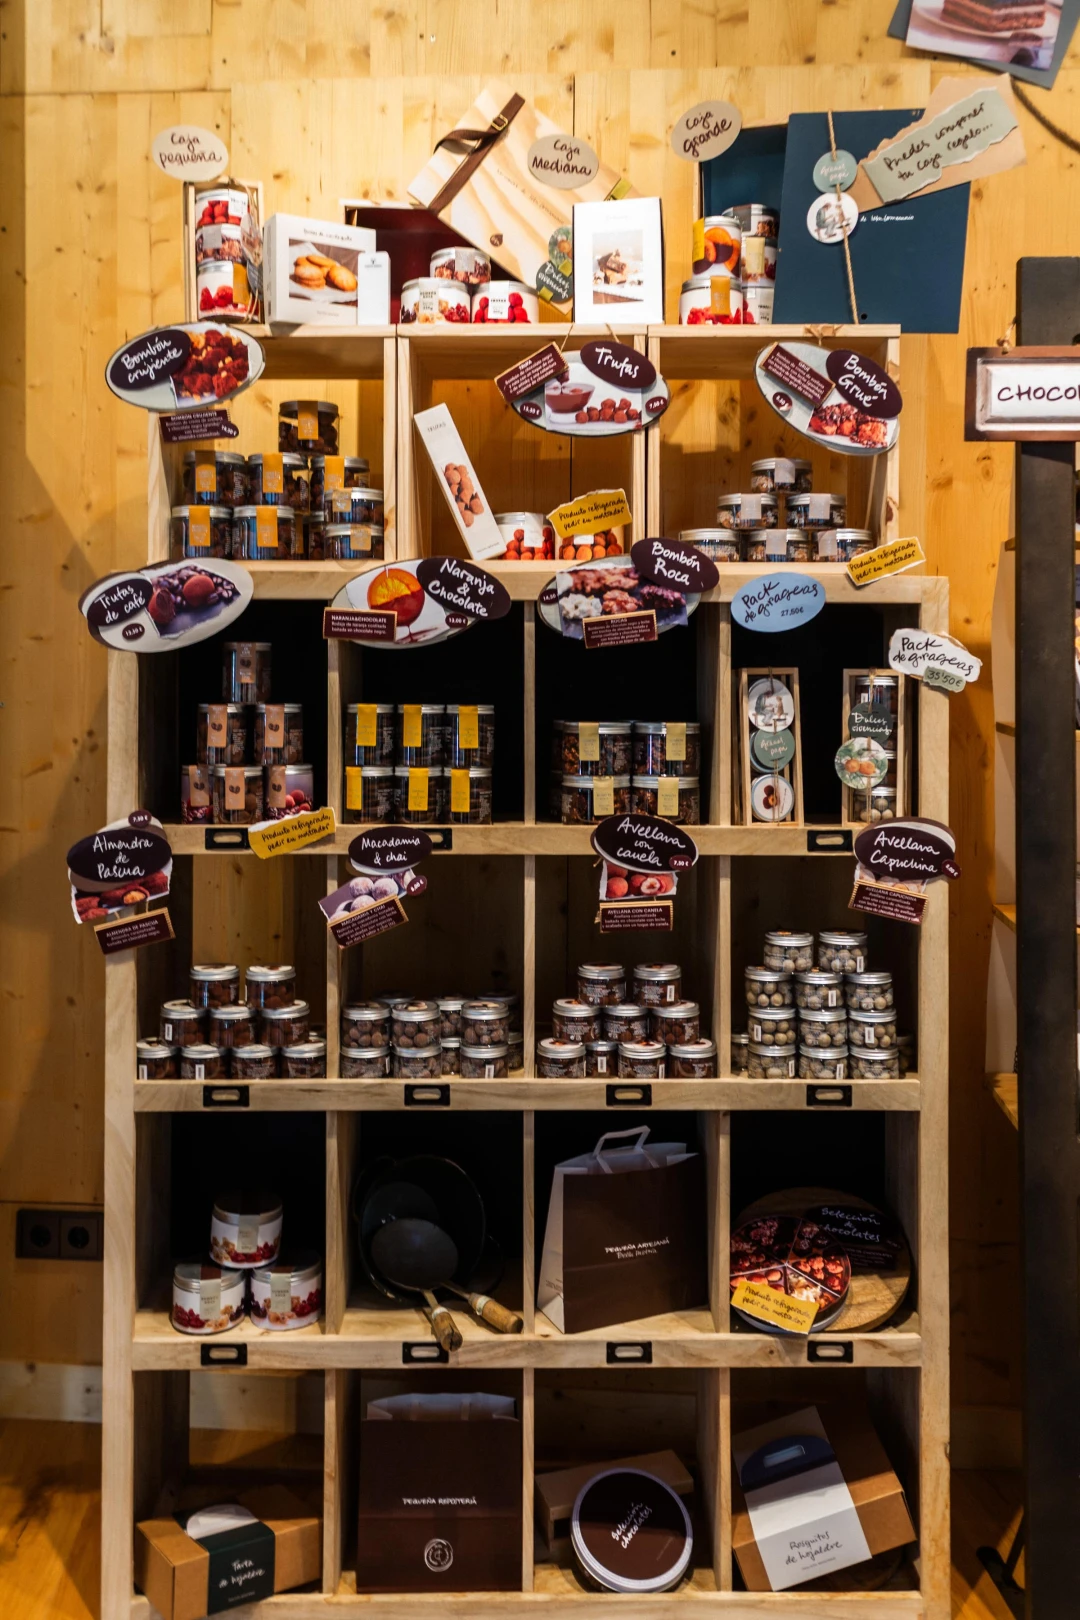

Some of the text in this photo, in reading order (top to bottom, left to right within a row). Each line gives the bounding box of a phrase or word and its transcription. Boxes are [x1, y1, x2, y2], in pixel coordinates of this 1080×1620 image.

[171, 132, 201, 153] Caja
[683, 118, 733, 158] grande
[159, 151, 222, 169] pequeña
[553, 139, 580, 162] Caja
[532, 156, 592, 176] Mediana
[121, 336, 172, 370] Bombón
[595, 347, 640, 379] Trufas
[128, 348, 183, 383] crujiente
[844, 354, 887, 401] Bombón
[652, 541, 701, 572] Bombón
[440, 558, 495, 597] Naranja
[654, 559, 690, 588] Roca
[94, 585, 136, 609] Trufas
[428, 580, 490, 618] Chocolate
[457, 582, 471, 596] &
[741, 581, 780, 609] Pack
[105, 590, 147, 625] de café
[744, 583, 819, 623] de grageas
[902, 637, 944, 652] Pack
[893, 650, 974, 677] de grageas
[93, 836, 154, 853] Almendra
[361, 836, 421, 850] Macadamia
[617, 817, 687, 849] Avellana
[874, 831, 941, 855] Avellana
[115, 851, 130, 864] de
[616, 847, 663, 867] canela
[634, 841, 654, 850] con
[373, 851, 408, 866] & chai
[870, 850, 938, 873] Capuchina
[98, 863, 146, 879] Pascua
[785, 1554, 798, 1566] de
